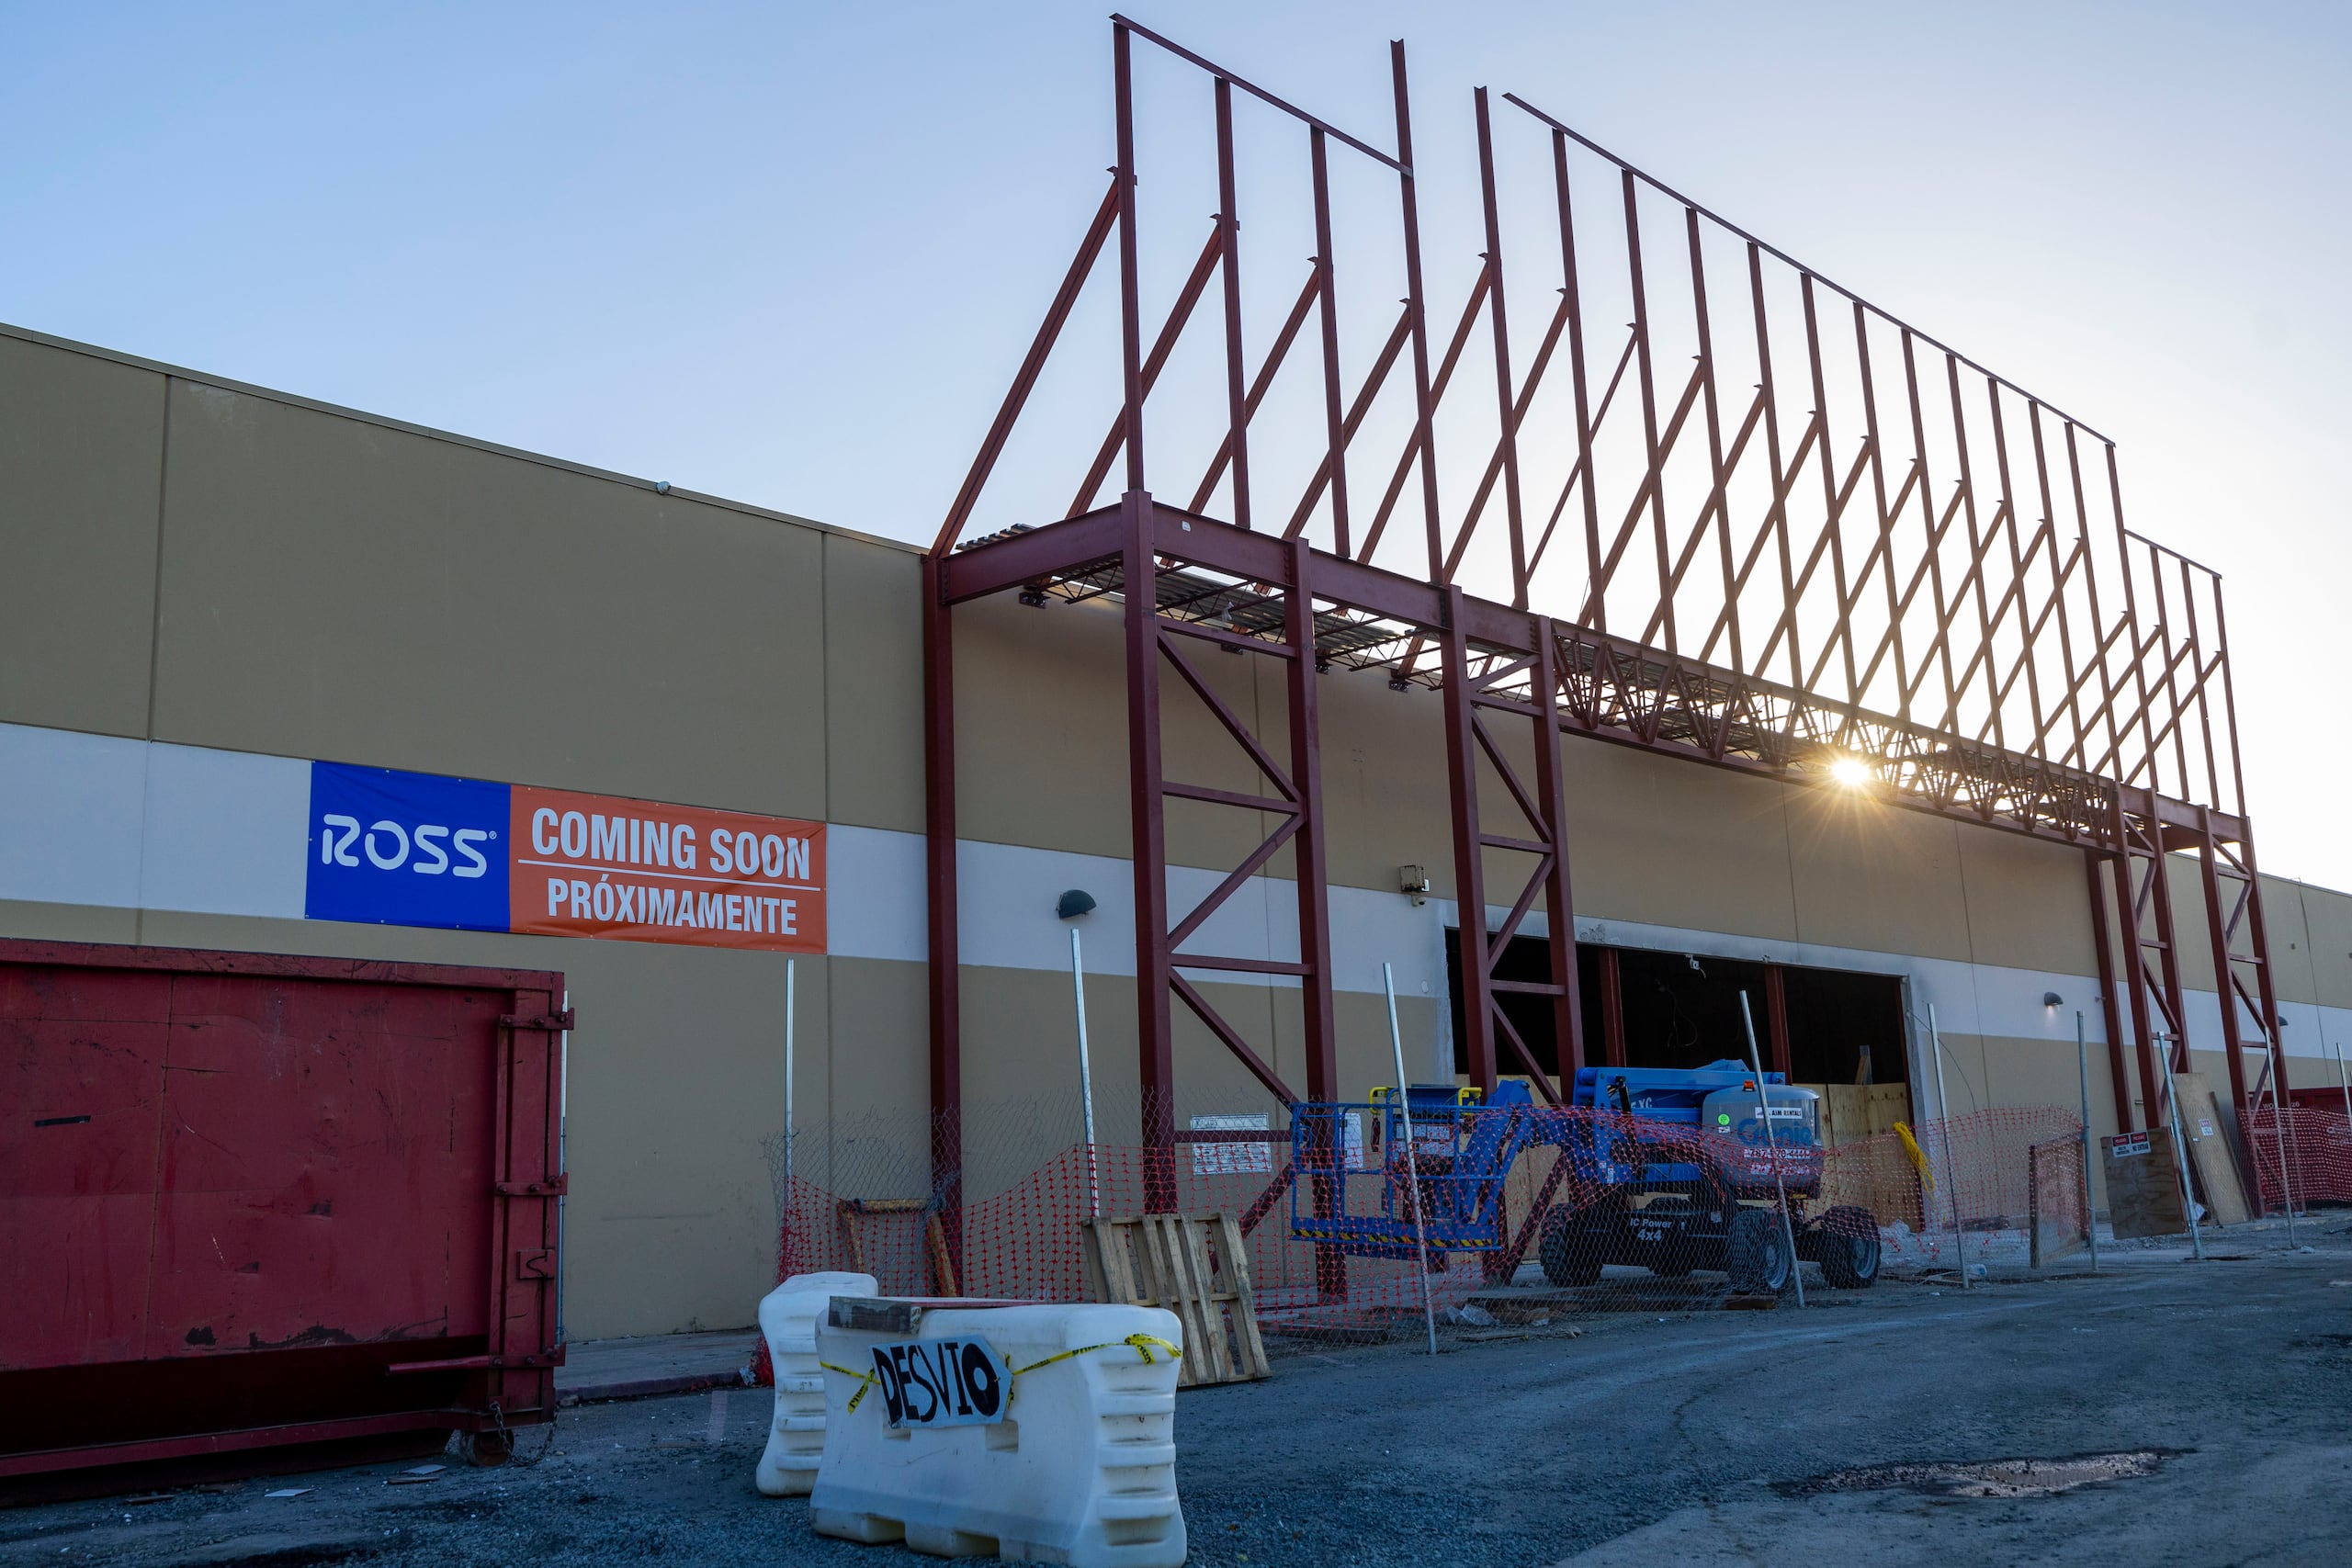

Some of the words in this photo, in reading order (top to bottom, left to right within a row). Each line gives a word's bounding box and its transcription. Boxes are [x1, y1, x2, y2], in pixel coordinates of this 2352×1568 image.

[532, 807, 696, 870] COMING
[709, 828, 810, 880] SOON
[548, 874, 797, 936] PRÓXIMAMENTE
[1637, 1229, 1662, 1242] 4x4
[1642, 1218, 1673, 1228] Power
[871, 1340, 1001, 1424] DESVIO
